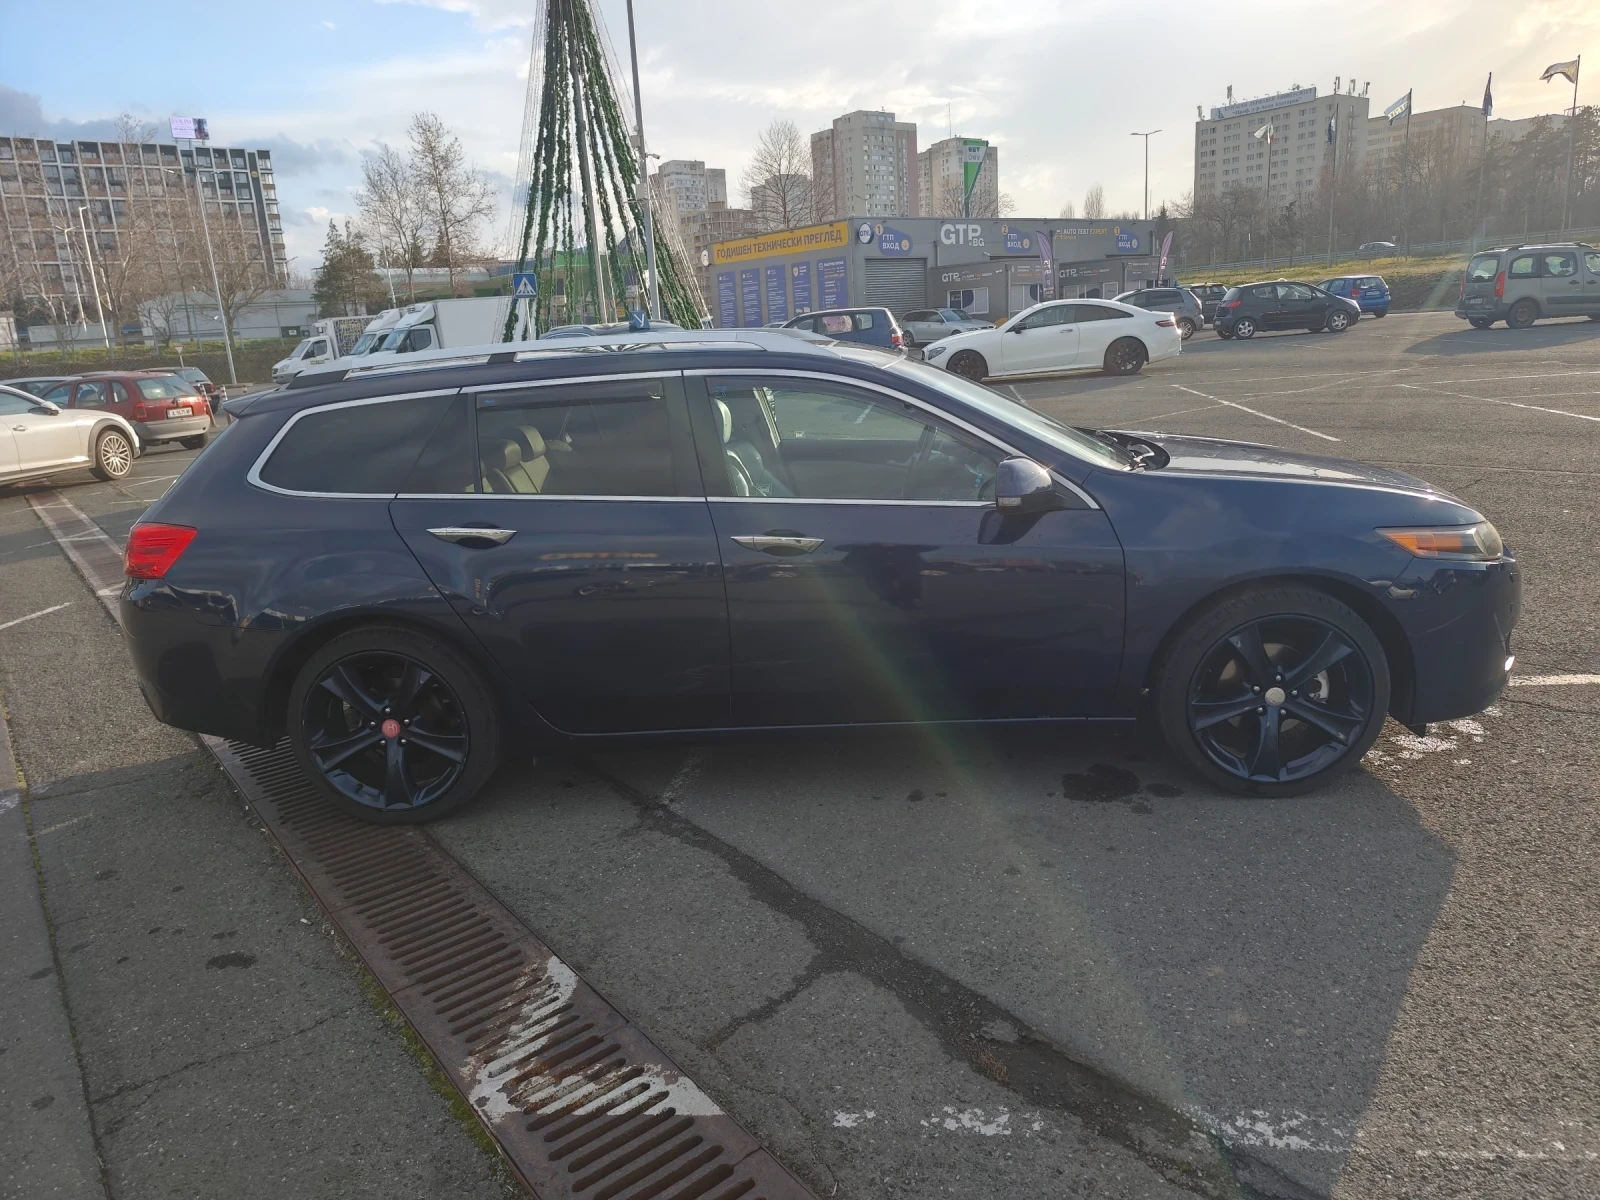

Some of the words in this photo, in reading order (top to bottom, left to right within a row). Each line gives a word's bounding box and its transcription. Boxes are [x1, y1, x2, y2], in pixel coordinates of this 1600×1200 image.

[940, 223, 982, 245] GTP
[716, 244, 752, 259] ГОДИШЕН
[753, 238, 802, 253] ТЕХНИЧЕСКИ
[804, 229, 843, 246] ПРЕГЛЕД
[882, 243, 900, 251] ВХОД
[1007, 241, 1022, 249] ВХОД
[1118, 241, 1131, 249] ВХОД
[941, 272, 960, 282] GTP
[1059, 268, 1077, 278] GTP
